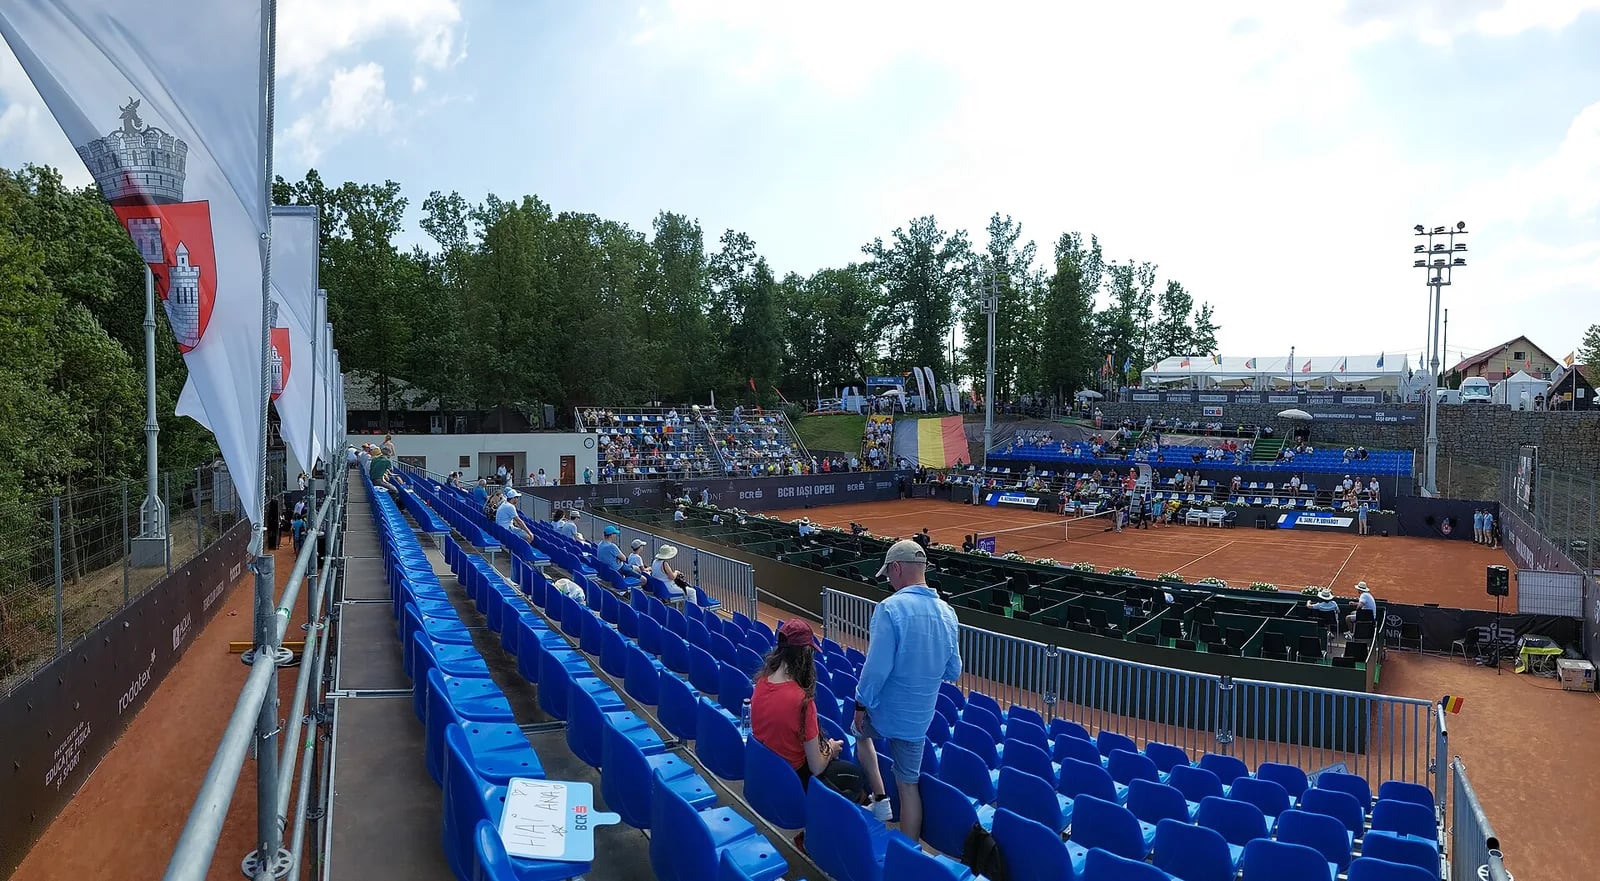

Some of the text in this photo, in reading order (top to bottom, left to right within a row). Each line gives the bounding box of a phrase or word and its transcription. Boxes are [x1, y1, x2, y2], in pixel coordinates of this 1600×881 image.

[777, 487, 795, 498] BCR
[814, 484, 835, 495] OPEN
[553, 500, 574, 510] BCR
[575, 814, 588, 831] BCR
